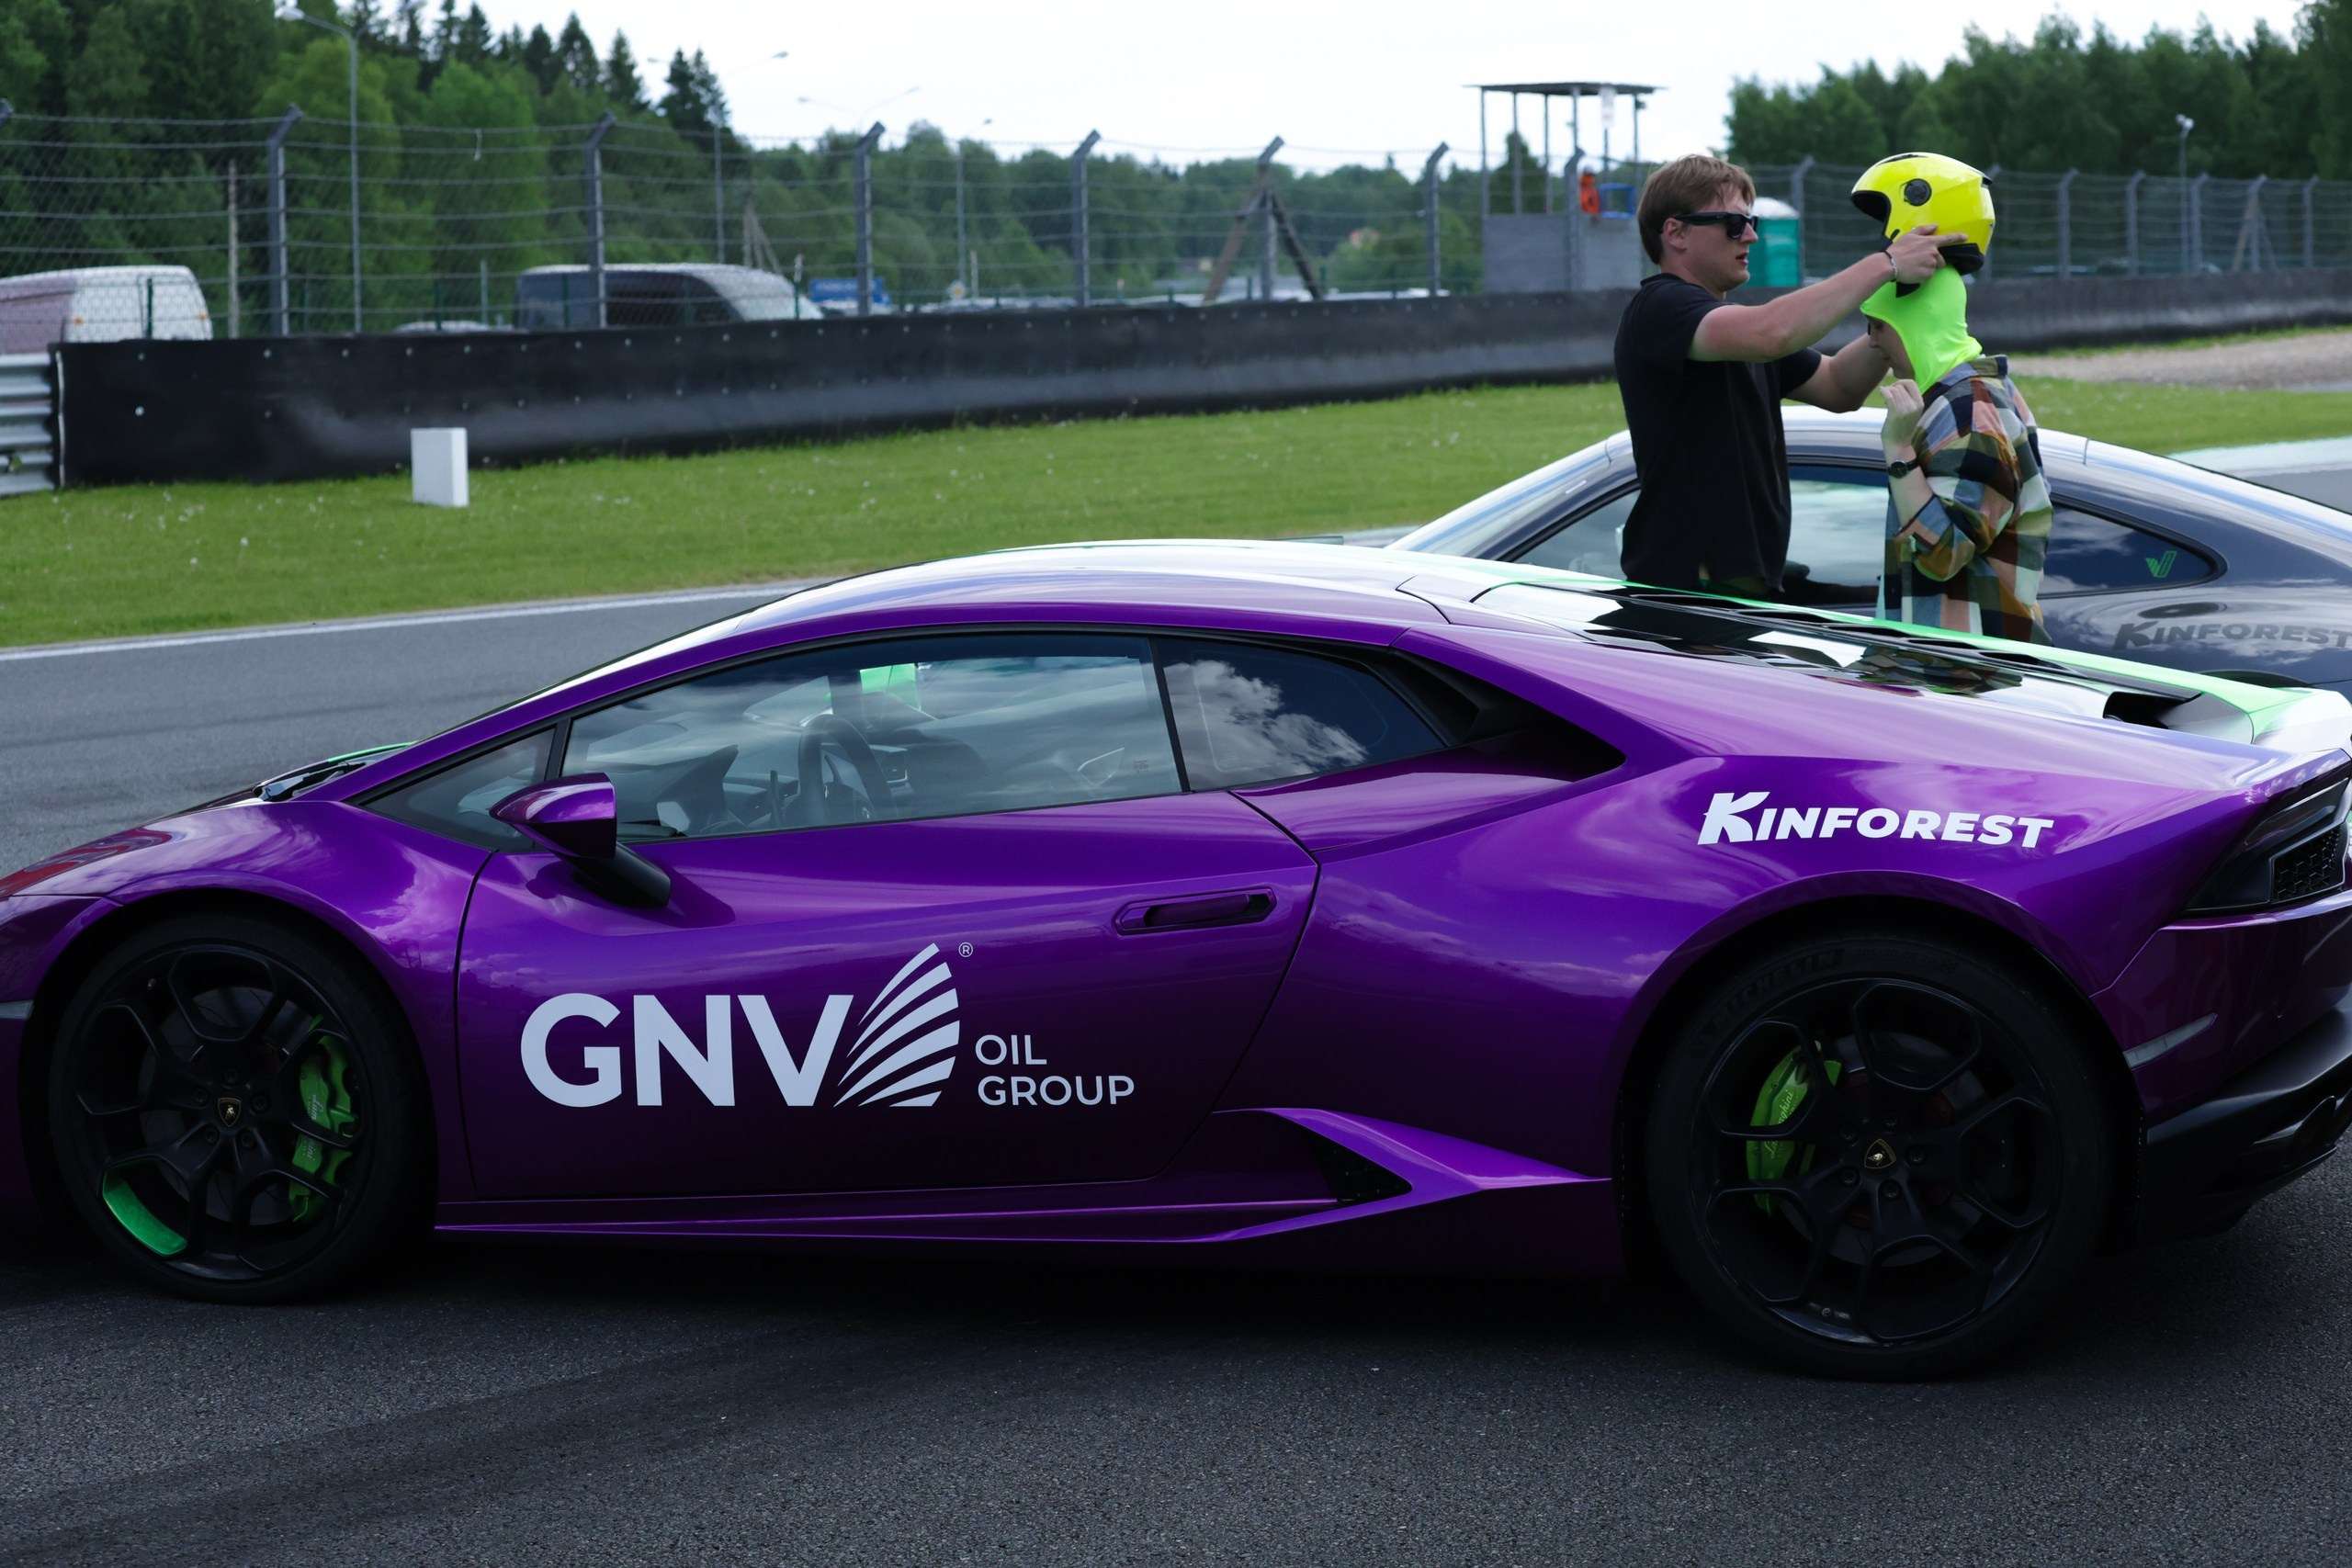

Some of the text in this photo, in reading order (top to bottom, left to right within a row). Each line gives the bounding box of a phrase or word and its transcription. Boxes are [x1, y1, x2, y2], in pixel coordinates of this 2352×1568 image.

[2112, 621, 2352, 650] KINFOREST
[1697, 791, 2054, 848] KINFOREST
[1711, 949, 1840, 1030] MICHELIN
[521, 993, 854, 1108] GNV
[975, 1034, 1047, 1066] OIL
[978, 1076, 1135, 1106] GROUP
